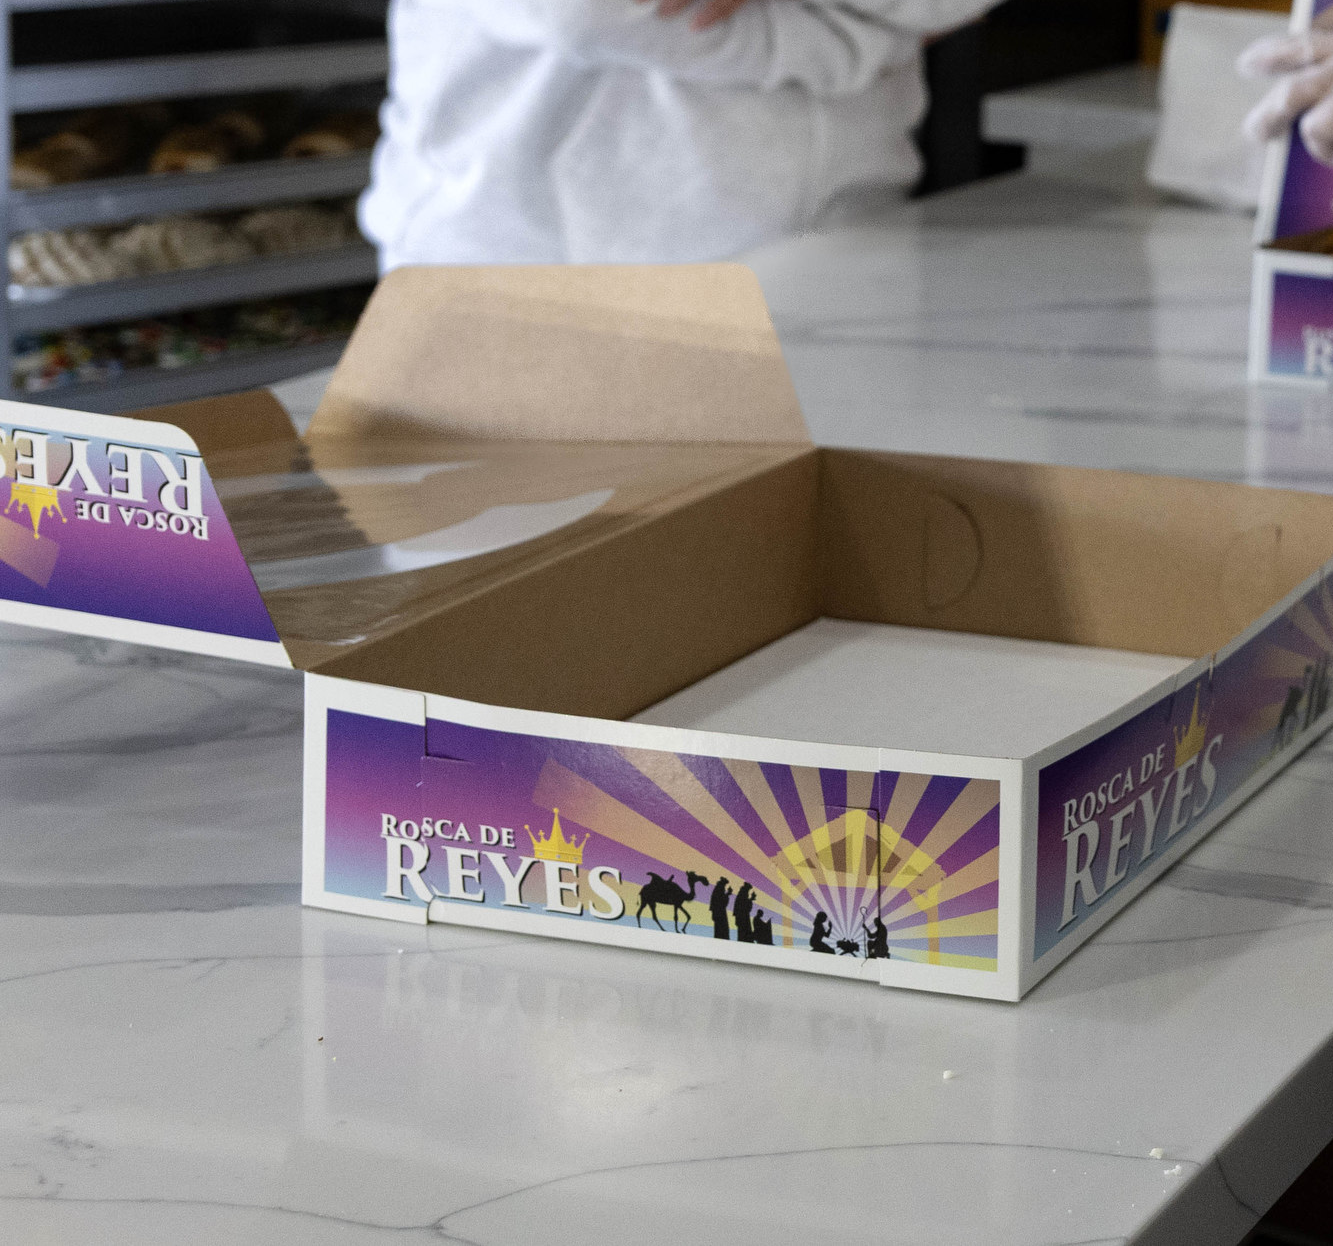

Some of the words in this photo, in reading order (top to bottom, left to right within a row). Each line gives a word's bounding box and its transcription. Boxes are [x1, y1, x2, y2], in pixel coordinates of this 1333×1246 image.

[0, 426, 205, 519] REYE
[75, 498, 111, 524] DE
[116, 504, 209, 541] ROSCA
[380, 812, 473, 843] ROSCA
[479, 823, 517, 848] DE
[1056, 732, 1224, 934] REYES
[1060, 766, 1136, 838] ROSCA
[1139, 742, 1166, 785] DE
[380, 834, 625, 921] REYES
